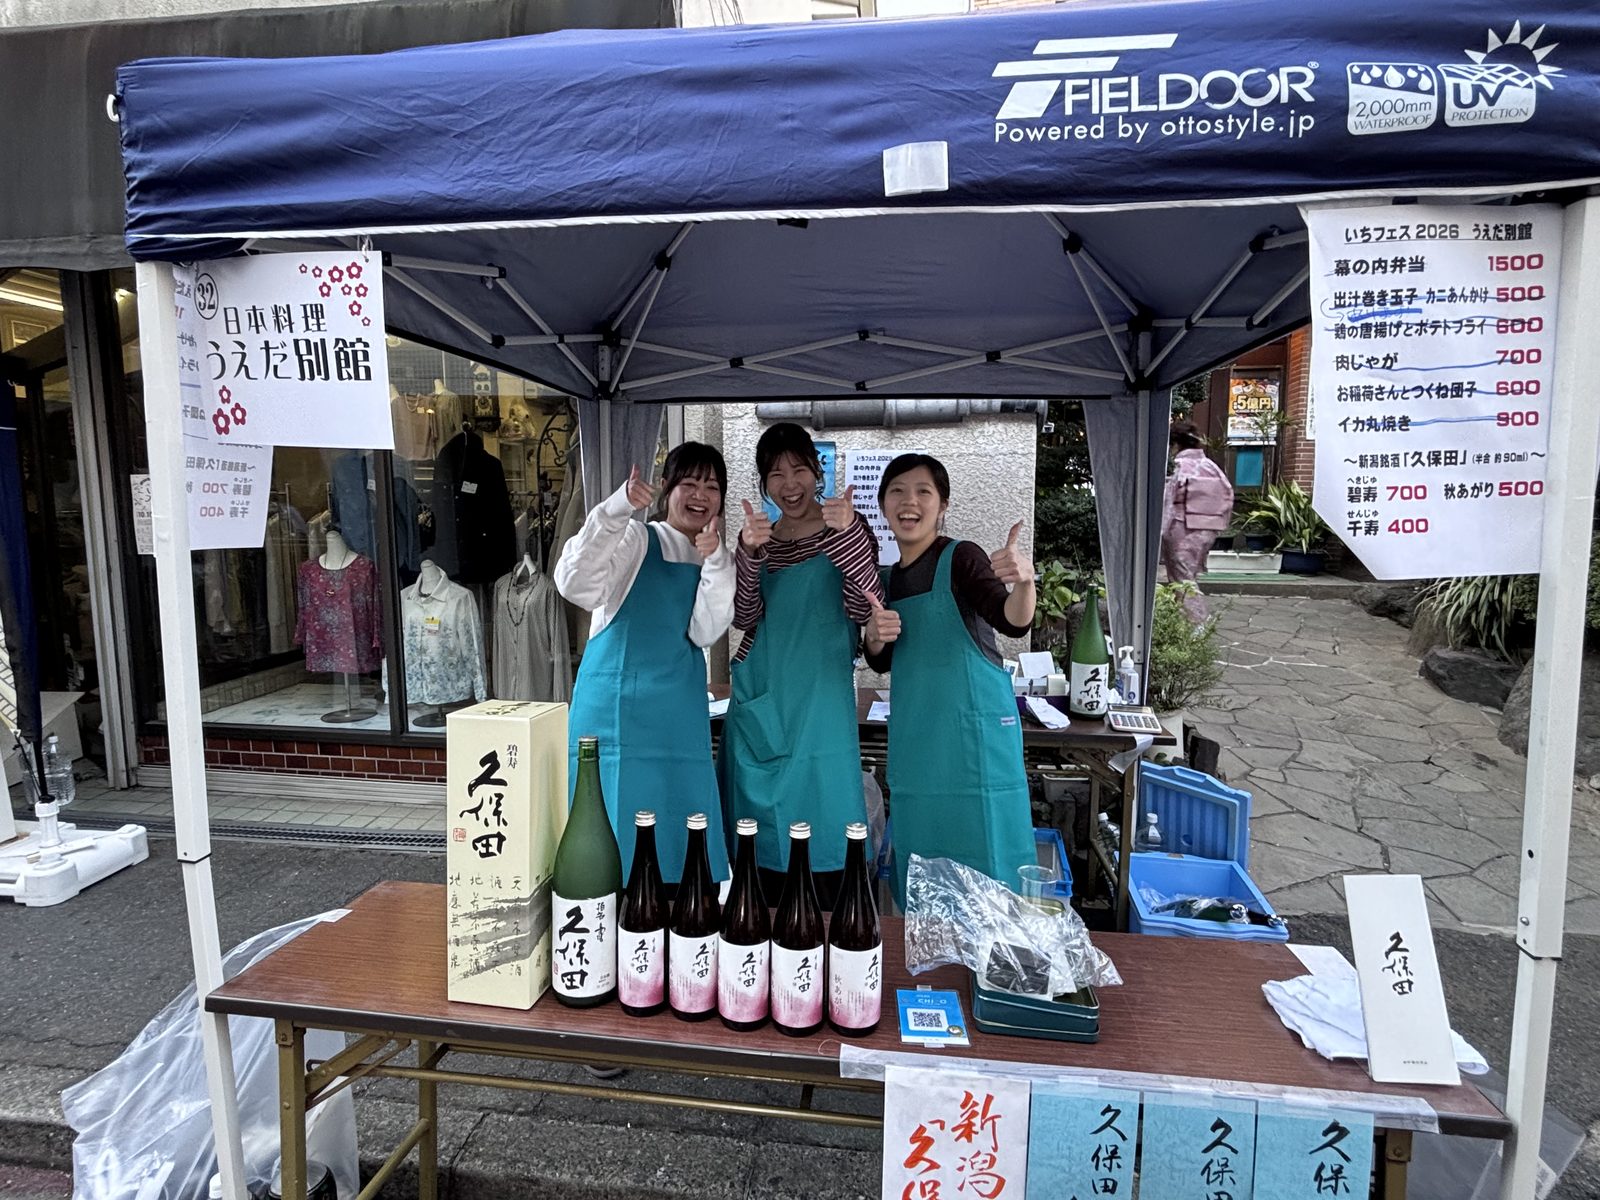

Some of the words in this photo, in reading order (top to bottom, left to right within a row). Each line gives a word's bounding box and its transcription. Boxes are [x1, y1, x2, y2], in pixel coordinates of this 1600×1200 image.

[1453, 83, 1505, 109] UV
[1355, 98, 1432, 119] 2,000mm
[1451, 107, 1529, 122] PROTECTION
[995, 116, 1105, 143] Powered
[1119, 115, 1149, 143] by
[1161, 109, 1315, 140] ottostyle.jp
[1354, 114, 1431, 130] WATERPROOF
[1345, 225, 1411, 243] いちフェス
[1416, 224, 1459, 239] 2026
[1472, 223, 1532, 241] うえだ別館
[1334, 255, 1425, 276] 幕の内弁当
[1488, 254, 1544, 271] 1500
[1334, 287, 1418, 309] 出汁巻き玉子
[1426, 286, 1488, 304] カニあんかけ
[1496, 285, 1544, 302] 500
[223, 303, 327, 335] 日本料理
[1496, 317, 1543, 334] 600
[206, 338, 372, 382] うえだ別館
[1336, 352, 1398, 371] 肉じゃが
[1496, 348, 1542, 365] 700
[1337, 381, 1477, 403] お稲荷さんとつくね団子
[1496, 380, 1540, 396] 600
[1338, 415, 1411, 433] イカ丸焼き
[1347, 486, 1377, 503] 碧寿
[1386, 485, 1427, 501] 700
[1444, 482, 1494, 500] 秋あがり
[1498, 480, 1544, 497] 500
[1347, 520, 1379, 537] 千寿
[1388, 518, 1429, 534] 400
[459, 750, 508, 858] 久保田
[555, 905, 590, 990] 久保田
[1382, 931, 1414, 995] 久保田
[1090, 1104, 1128, 1195] 久保田
